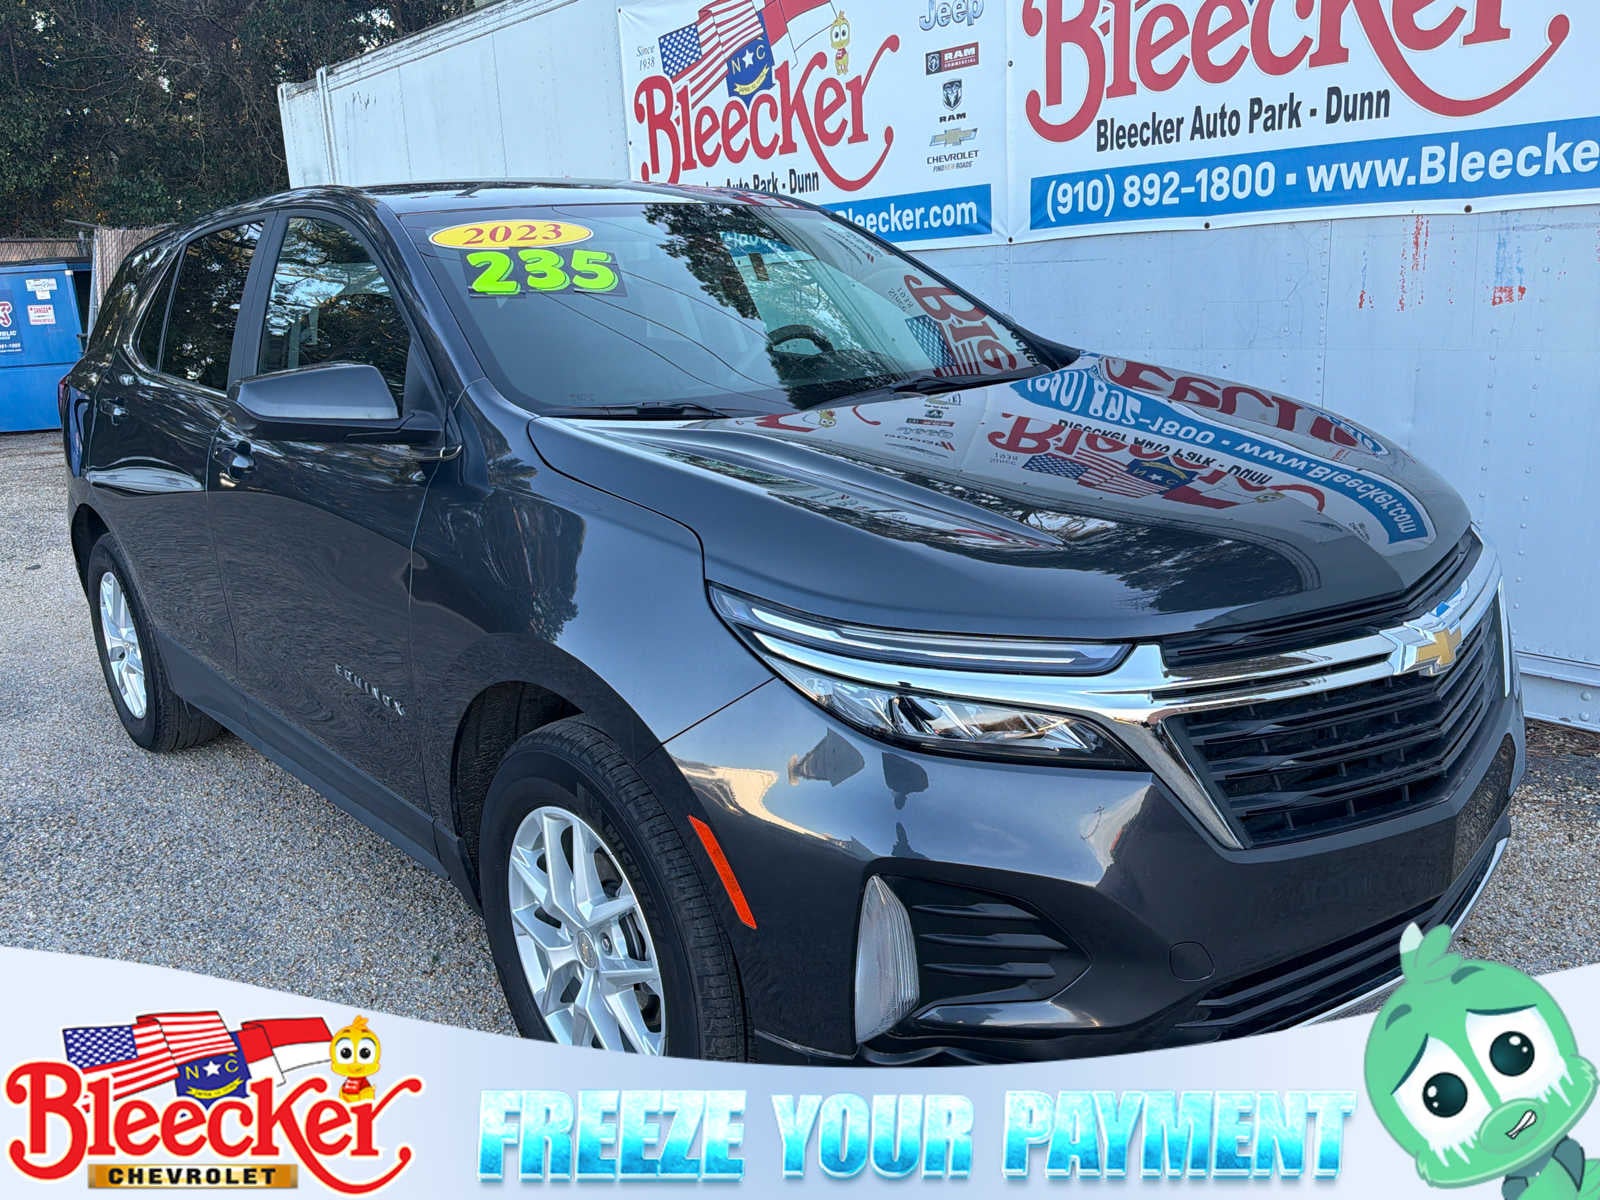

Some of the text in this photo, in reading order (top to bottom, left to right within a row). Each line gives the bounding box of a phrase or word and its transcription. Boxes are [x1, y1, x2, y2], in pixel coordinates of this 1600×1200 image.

[919, 0, 984, 31] Jeep
[731, 44, 767, 75] N C
[944, 47, 976, 61] RAM
[634, 34, 900, 191] Bleecker
[939, 112, 967, 123] RAM
[1096, 86, 1391, 152] Bleecker Auto Park Dunn
[926, 150, 979, 165] CHEVROLET
[753, 171, 779, 194] Park
[789, 168, 819, 194] Dunn
[1046, 131, 1600, 222] (910) 892-1800 www.Bleecke
[463, 224, 563, 245] 2023
[466, 249, 619, 295] 235
[335, 663, 406, 716] EQUINOX
